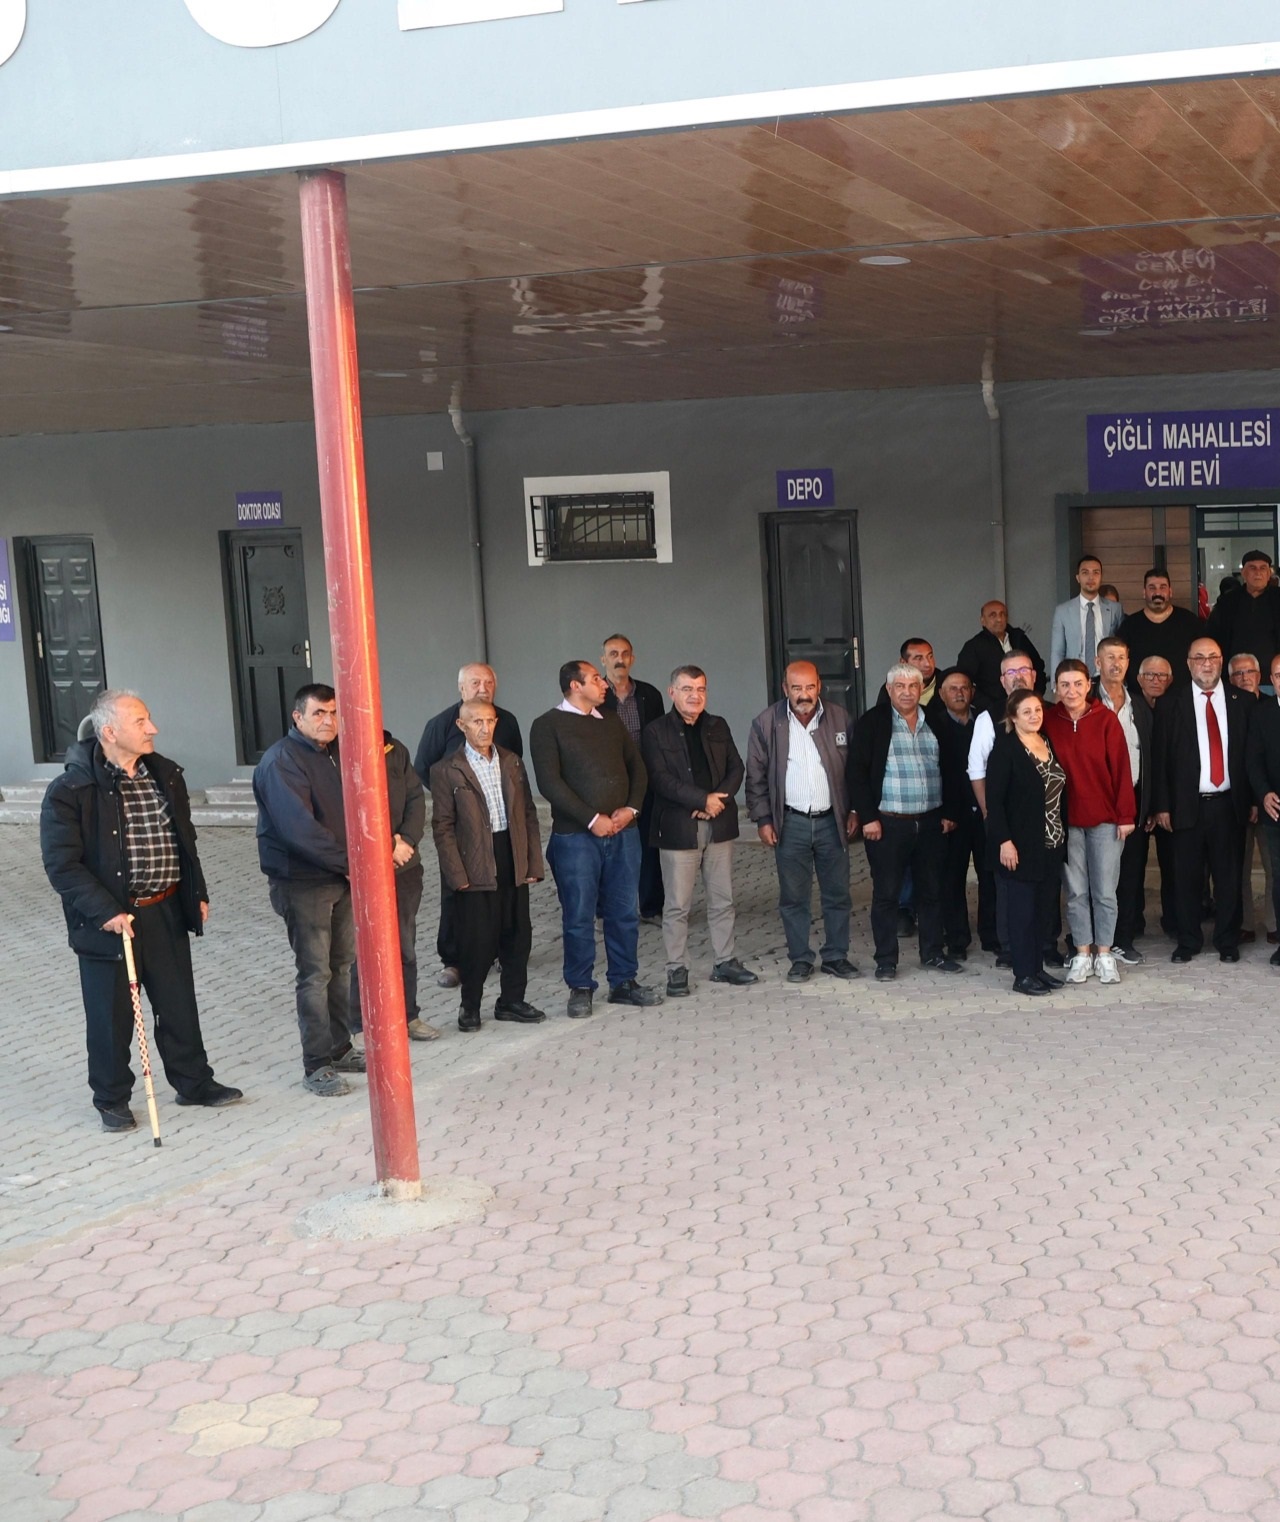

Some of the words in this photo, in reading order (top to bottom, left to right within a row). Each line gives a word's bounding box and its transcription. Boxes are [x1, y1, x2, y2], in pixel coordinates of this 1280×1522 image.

[1103, 418, 1152, 457] ÇİĞLİ
[1162, 414, 1271, 449] MAHALLESİ
[1144, 461, 1185, 487] CEM
[1190, 453, 1220, 485] EVİ
[787, 477, 823, 501] DEPO
[237, 503, 262, 520] DOKTOR
[262, 502, 281, 520] ODASI
